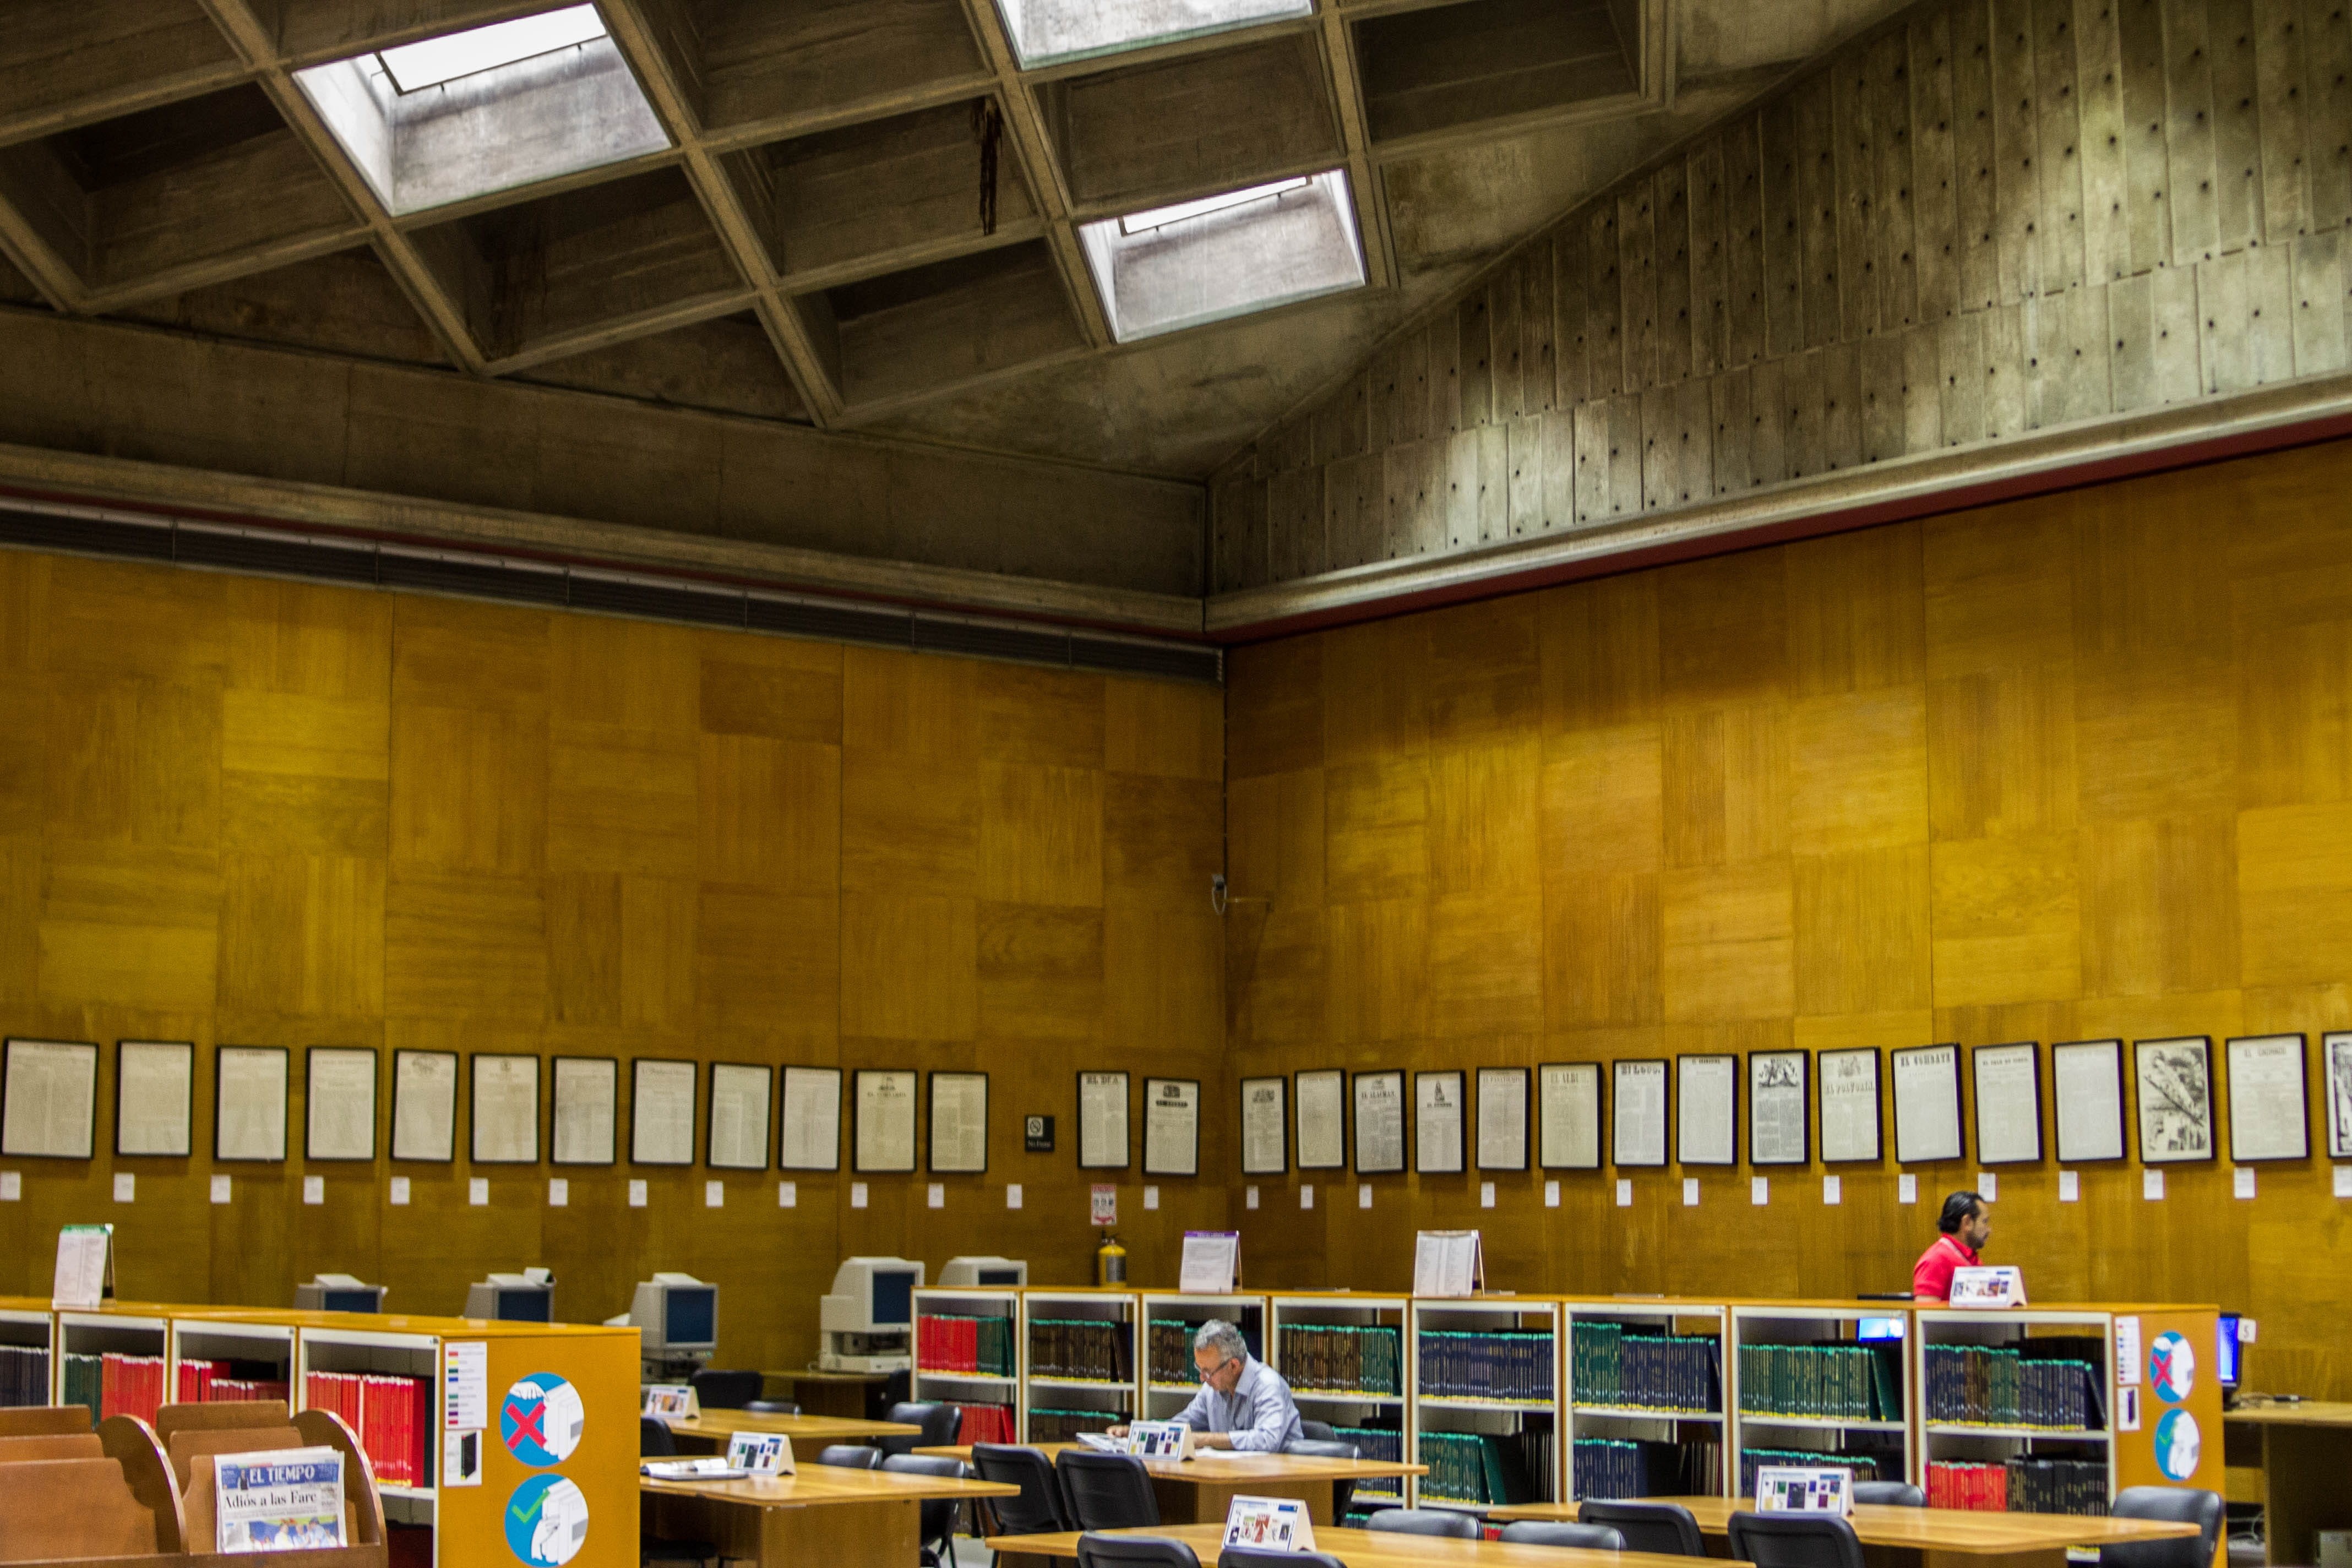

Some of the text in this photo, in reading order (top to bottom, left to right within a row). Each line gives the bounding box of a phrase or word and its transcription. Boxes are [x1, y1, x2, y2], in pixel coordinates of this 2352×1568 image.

[2244, 1324, 2250, 1338] 5
[249, 1468, 264, 1484] EL
[268, 1465, 315, 1483] TIEMPO
[226, 1493, 256, 1509] Adiós
[260, 1498, 267, 1506] a
[271, 1491, 286, 1506] las
[291, 1490, 317, 1504] Farc
